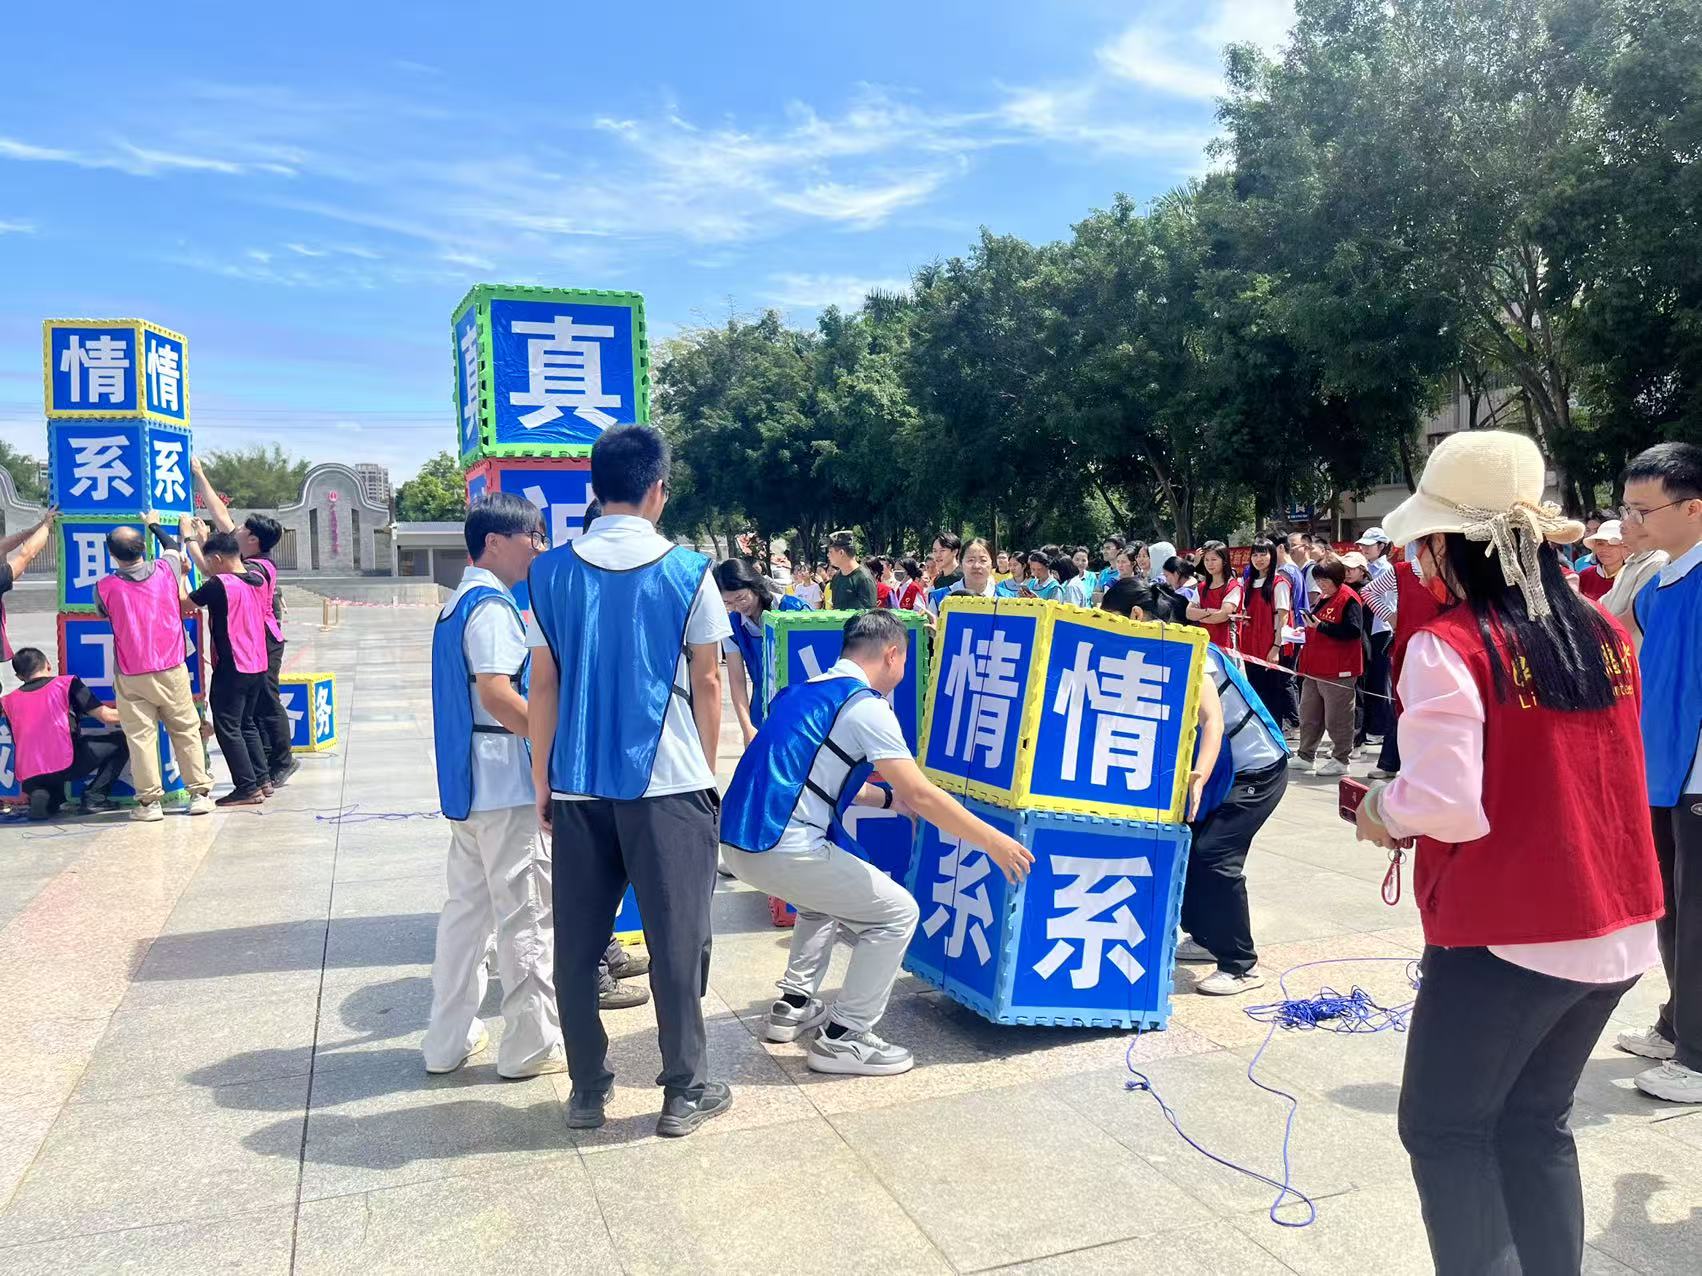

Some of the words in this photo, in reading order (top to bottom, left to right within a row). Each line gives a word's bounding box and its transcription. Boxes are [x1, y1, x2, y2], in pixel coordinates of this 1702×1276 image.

[60, 335, 129, 403] 情
[148, 339, 180, 411] 情
[509, 316, 621, 430] 真
[68, 435, 135, 500] 系
[153, 440, 187, 503] 系
[316, 686, 332, 738] 务
[943, 628, 1022, 770] 情
[1054, 641, 1171, 791] 情
[922, 828, 994, 967] 系
[1032, 855, 1154, 990] 系
